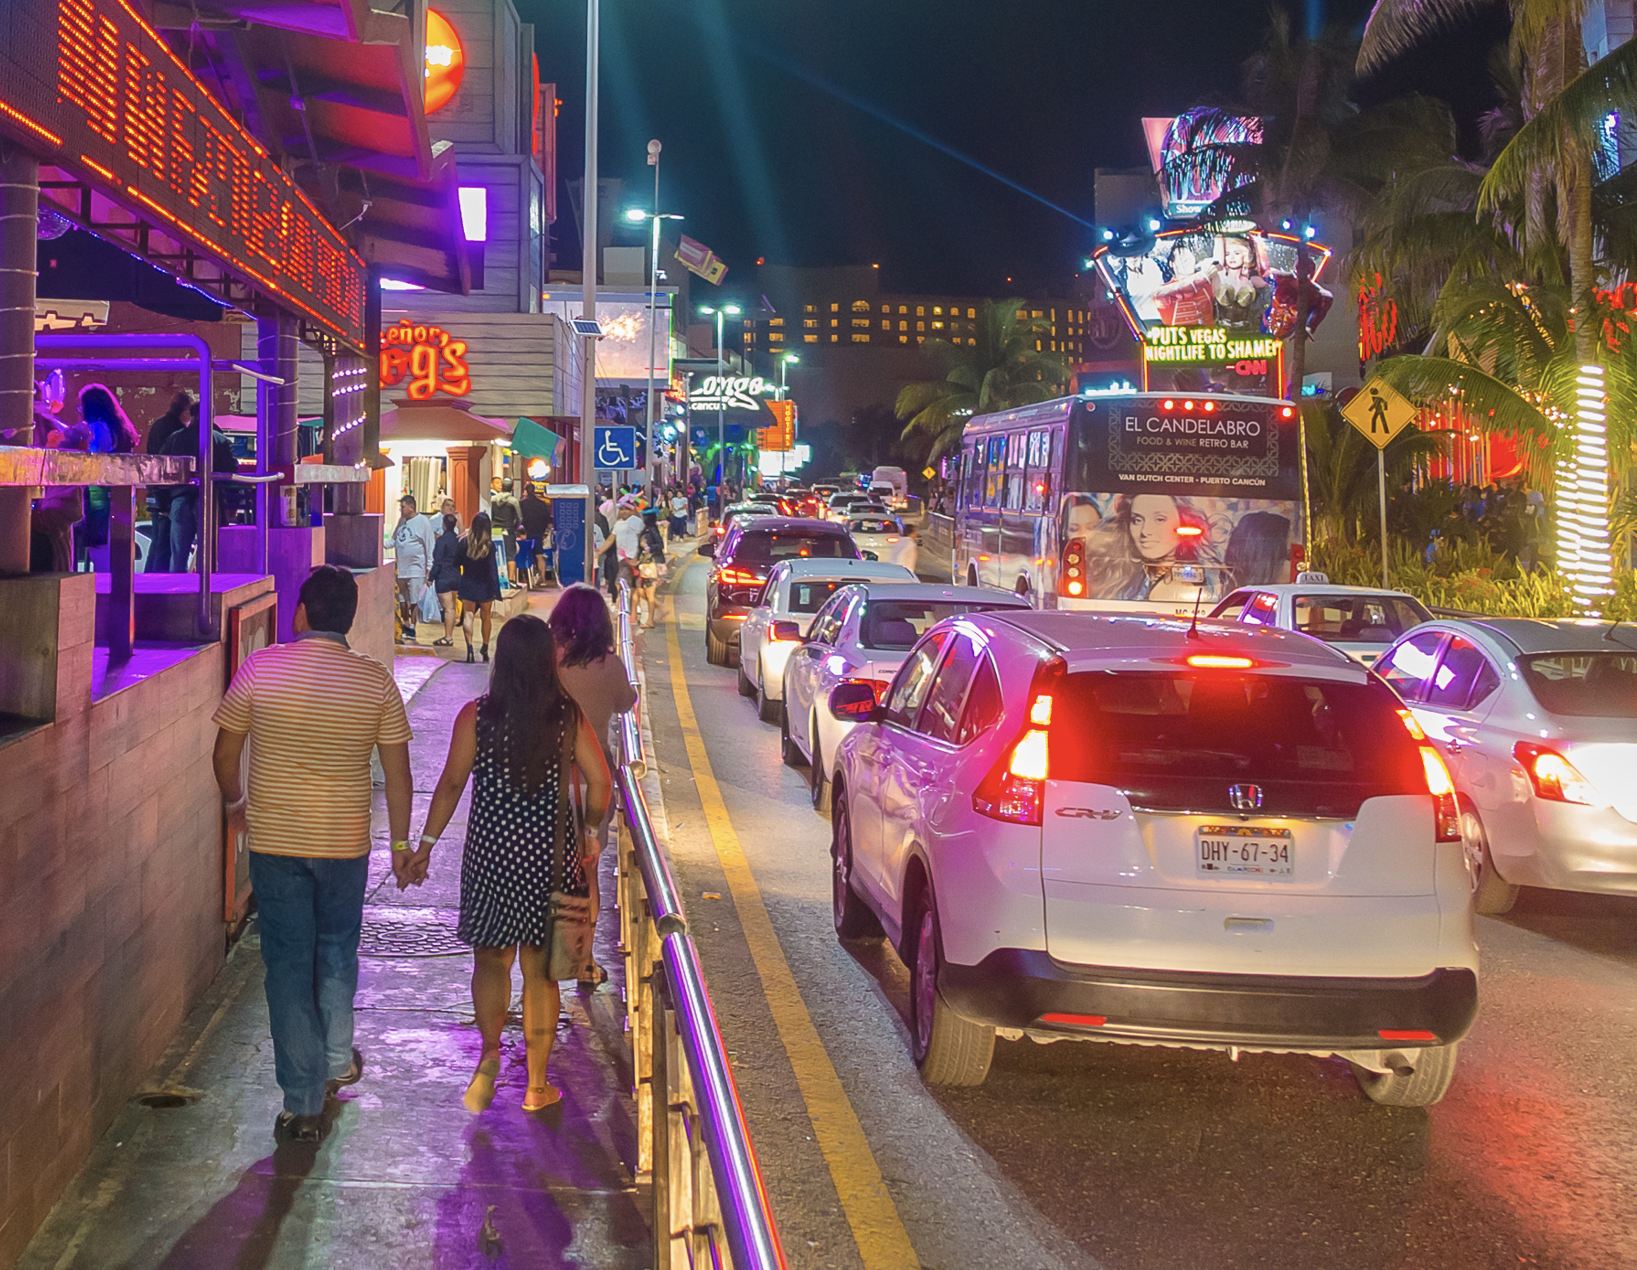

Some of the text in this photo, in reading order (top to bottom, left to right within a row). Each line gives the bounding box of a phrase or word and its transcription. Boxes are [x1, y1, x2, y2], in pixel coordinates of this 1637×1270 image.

[380, 318, 440, 346] eñor
[1189, 328, 1227, 344] VEGAS
[1145, 344, 1206, 361] NIGHTLIFE
[1208, 344, 1226, 359] TO
[1125, 416, 1261, 436] EL CANDELABRO
[1136, 436, 1249, 449] FOOD & WINE RETRO BAR
[1119, 473, 1135, 481] VAN
[1136, 474, 1163, 482] DUTCH
[1164, 475, 1194, 483] CENTER
[1200, 477, 1230, 485] PUERTO
[1304, 574, 1324, 582] TAXI
[1055, 807, 1122, 820] CR-V
[1201, 840, 1288, 862] DHY-67-34
